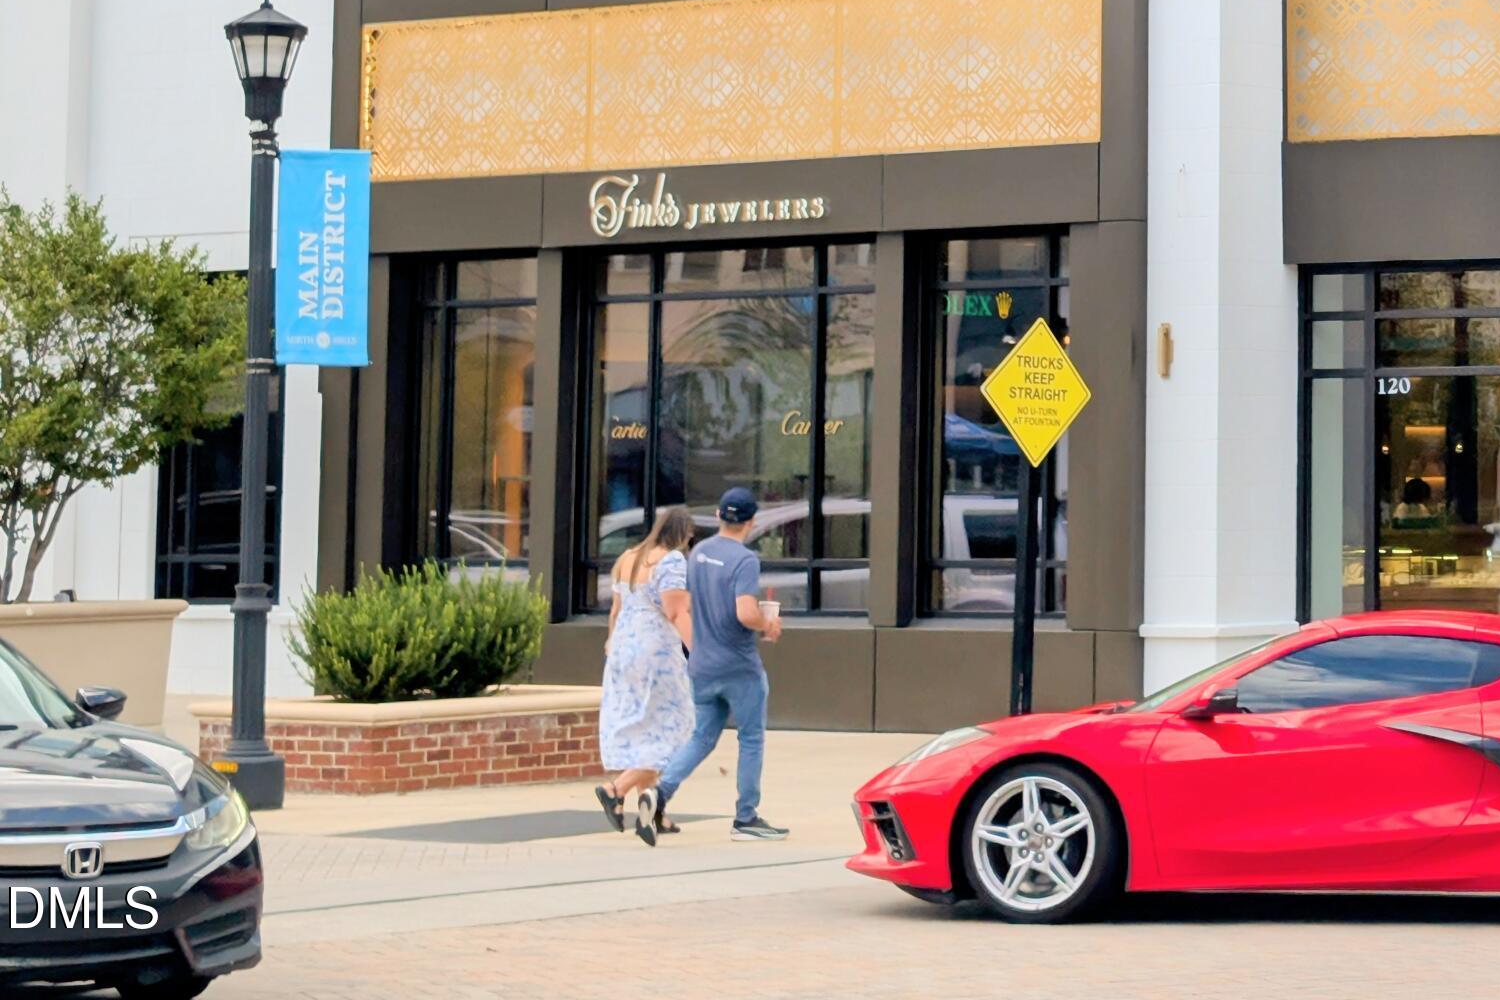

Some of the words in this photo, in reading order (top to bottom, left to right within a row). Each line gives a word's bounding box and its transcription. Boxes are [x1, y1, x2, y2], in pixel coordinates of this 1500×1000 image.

[589, 172, 680, 238] Fink's
[684, 197, 825, 230] JEWELERS
[321, 169, 347, 320] DISTRICT
[298, 231, 319, 320] MAIN
[1016, 354, 1064, 370] TRUCKS
[1024, 371, 1056, 385] KEEP
[1377, 377, 1411, 395] 120
[1008, 386, 1068, 402] STRAIGHT
[1017, 406, 1029, 415] NO
